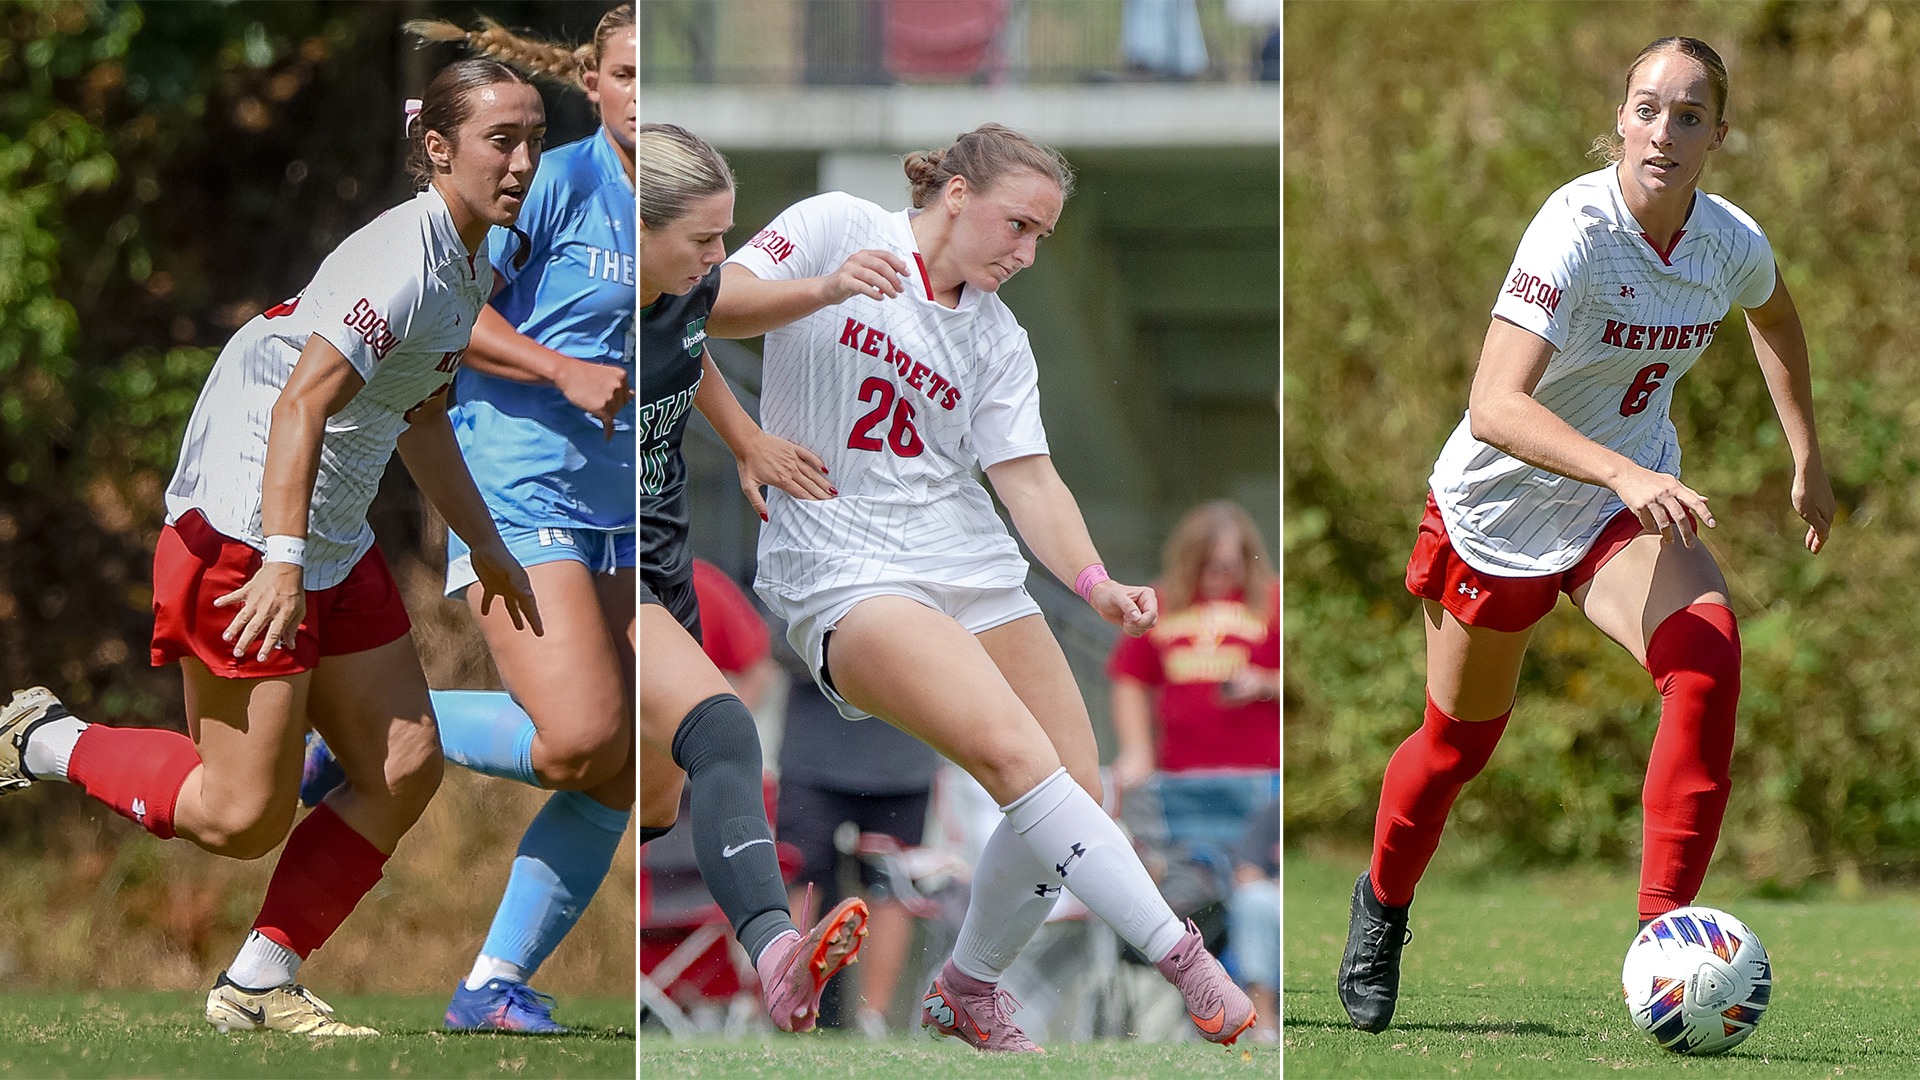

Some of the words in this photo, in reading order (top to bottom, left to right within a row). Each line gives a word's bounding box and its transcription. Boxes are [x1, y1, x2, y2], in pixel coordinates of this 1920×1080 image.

[586, 245, 636, 287] THE
[1506, 267, 1564, 319] SOCON
[839, 317, 962, 411] KEYDETS
[1619, 362, 1670, 418] 6
[847, 376, 925, 458] 26
